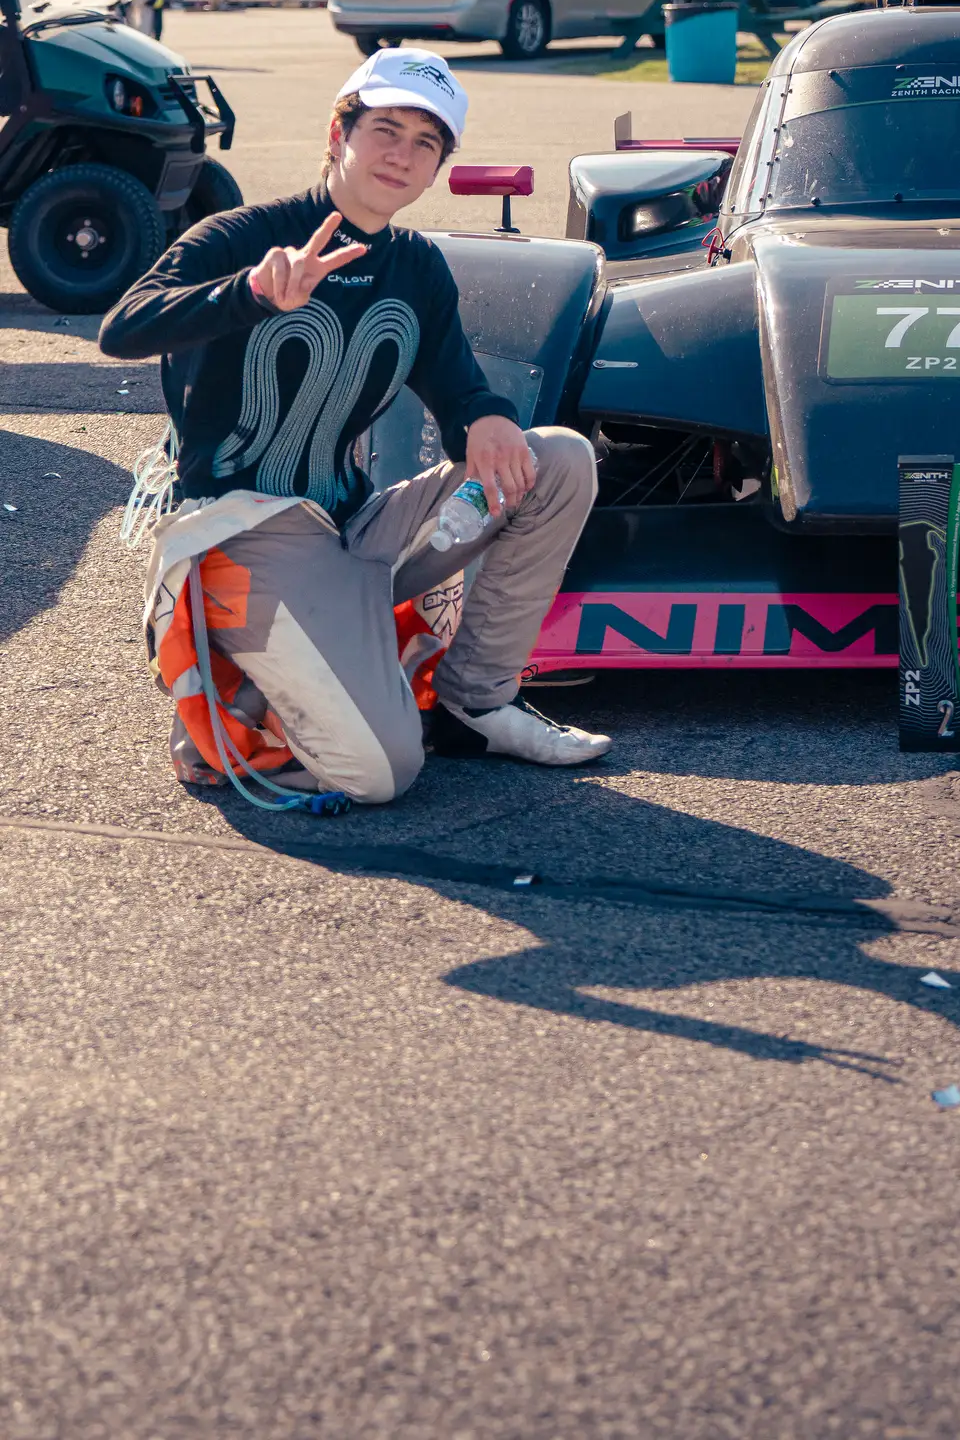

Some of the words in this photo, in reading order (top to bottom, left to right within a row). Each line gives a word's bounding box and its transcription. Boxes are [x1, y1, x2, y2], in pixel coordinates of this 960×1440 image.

[891, 89, 928, 97] ZENITH
[905, 356, 957, 370] ZP2
[905, 669, 920, 706] ZP2
[937, 700, 955, 737] 2
